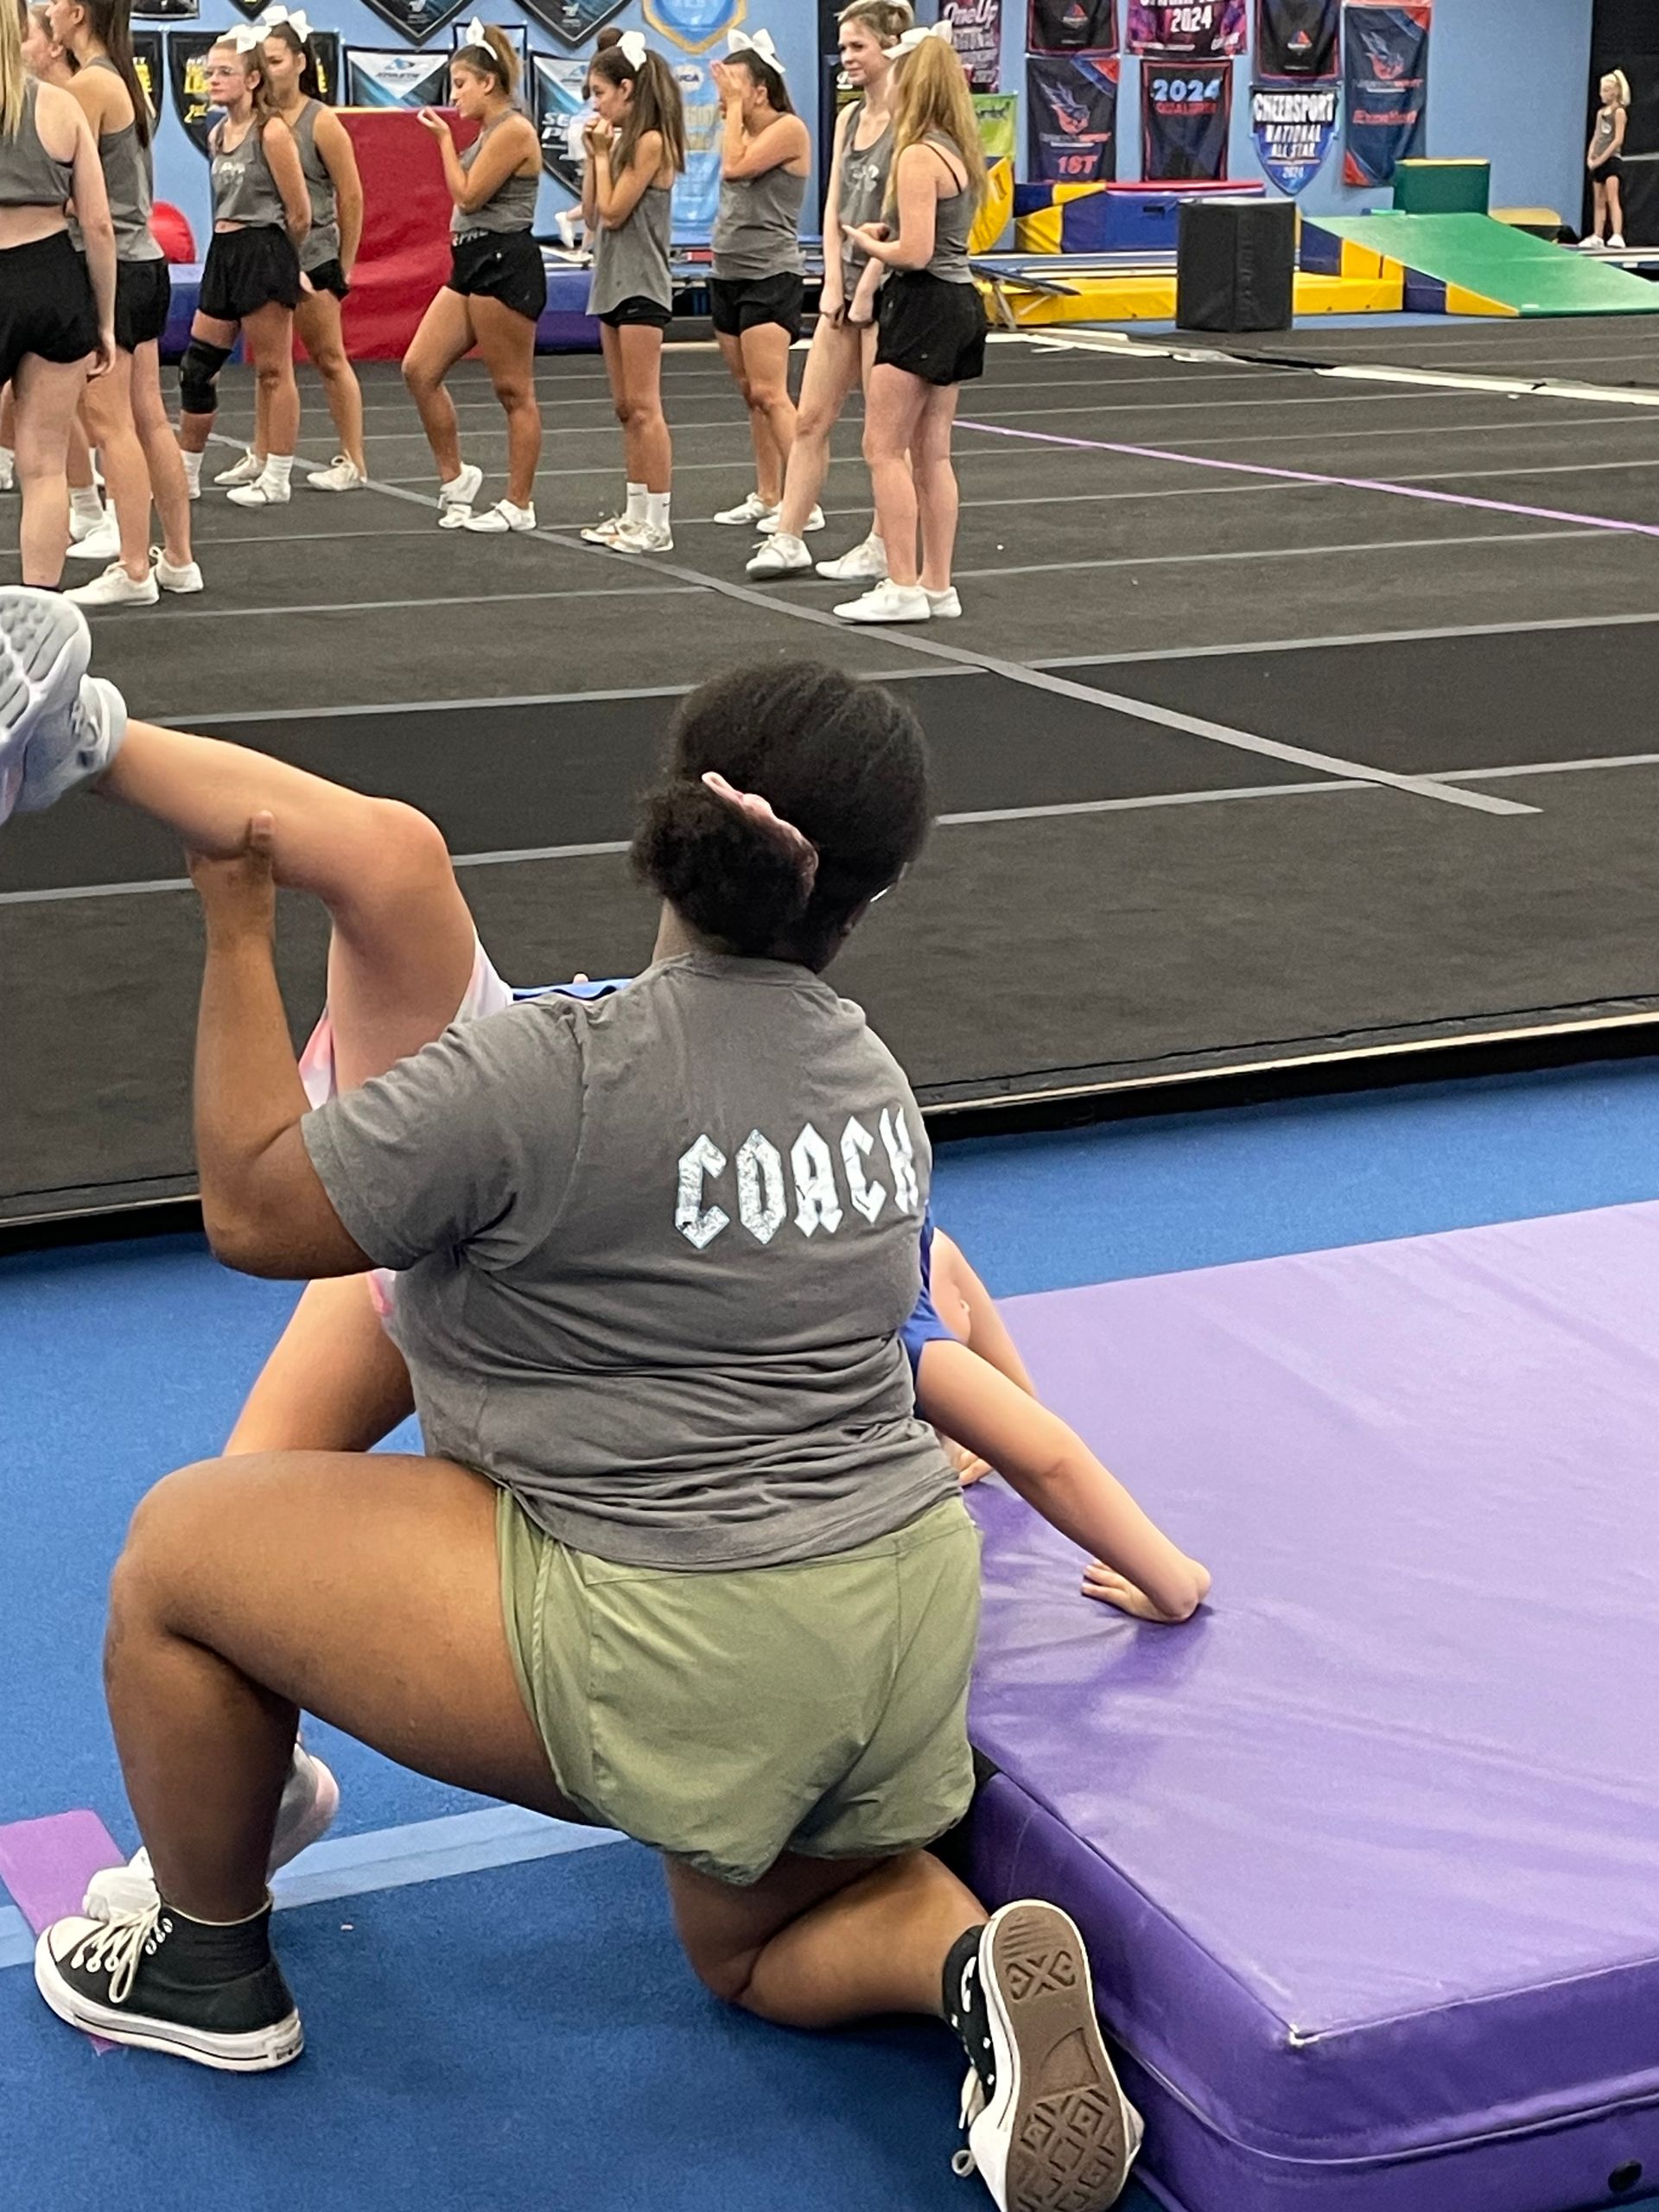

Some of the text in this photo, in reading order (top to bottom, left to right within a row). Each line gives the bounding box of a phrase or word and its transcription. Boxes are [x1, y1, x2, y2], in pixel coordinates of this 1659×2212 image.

[1171, 5, 1213, 33] 2024
[1153, 79, 1222, 101] 2024
[1254, 92, 1335, 122] CHEERSPORT
[1265, 124, 1321, 143] NATIONAL
[675, 1107, 919, 1249] COACH
